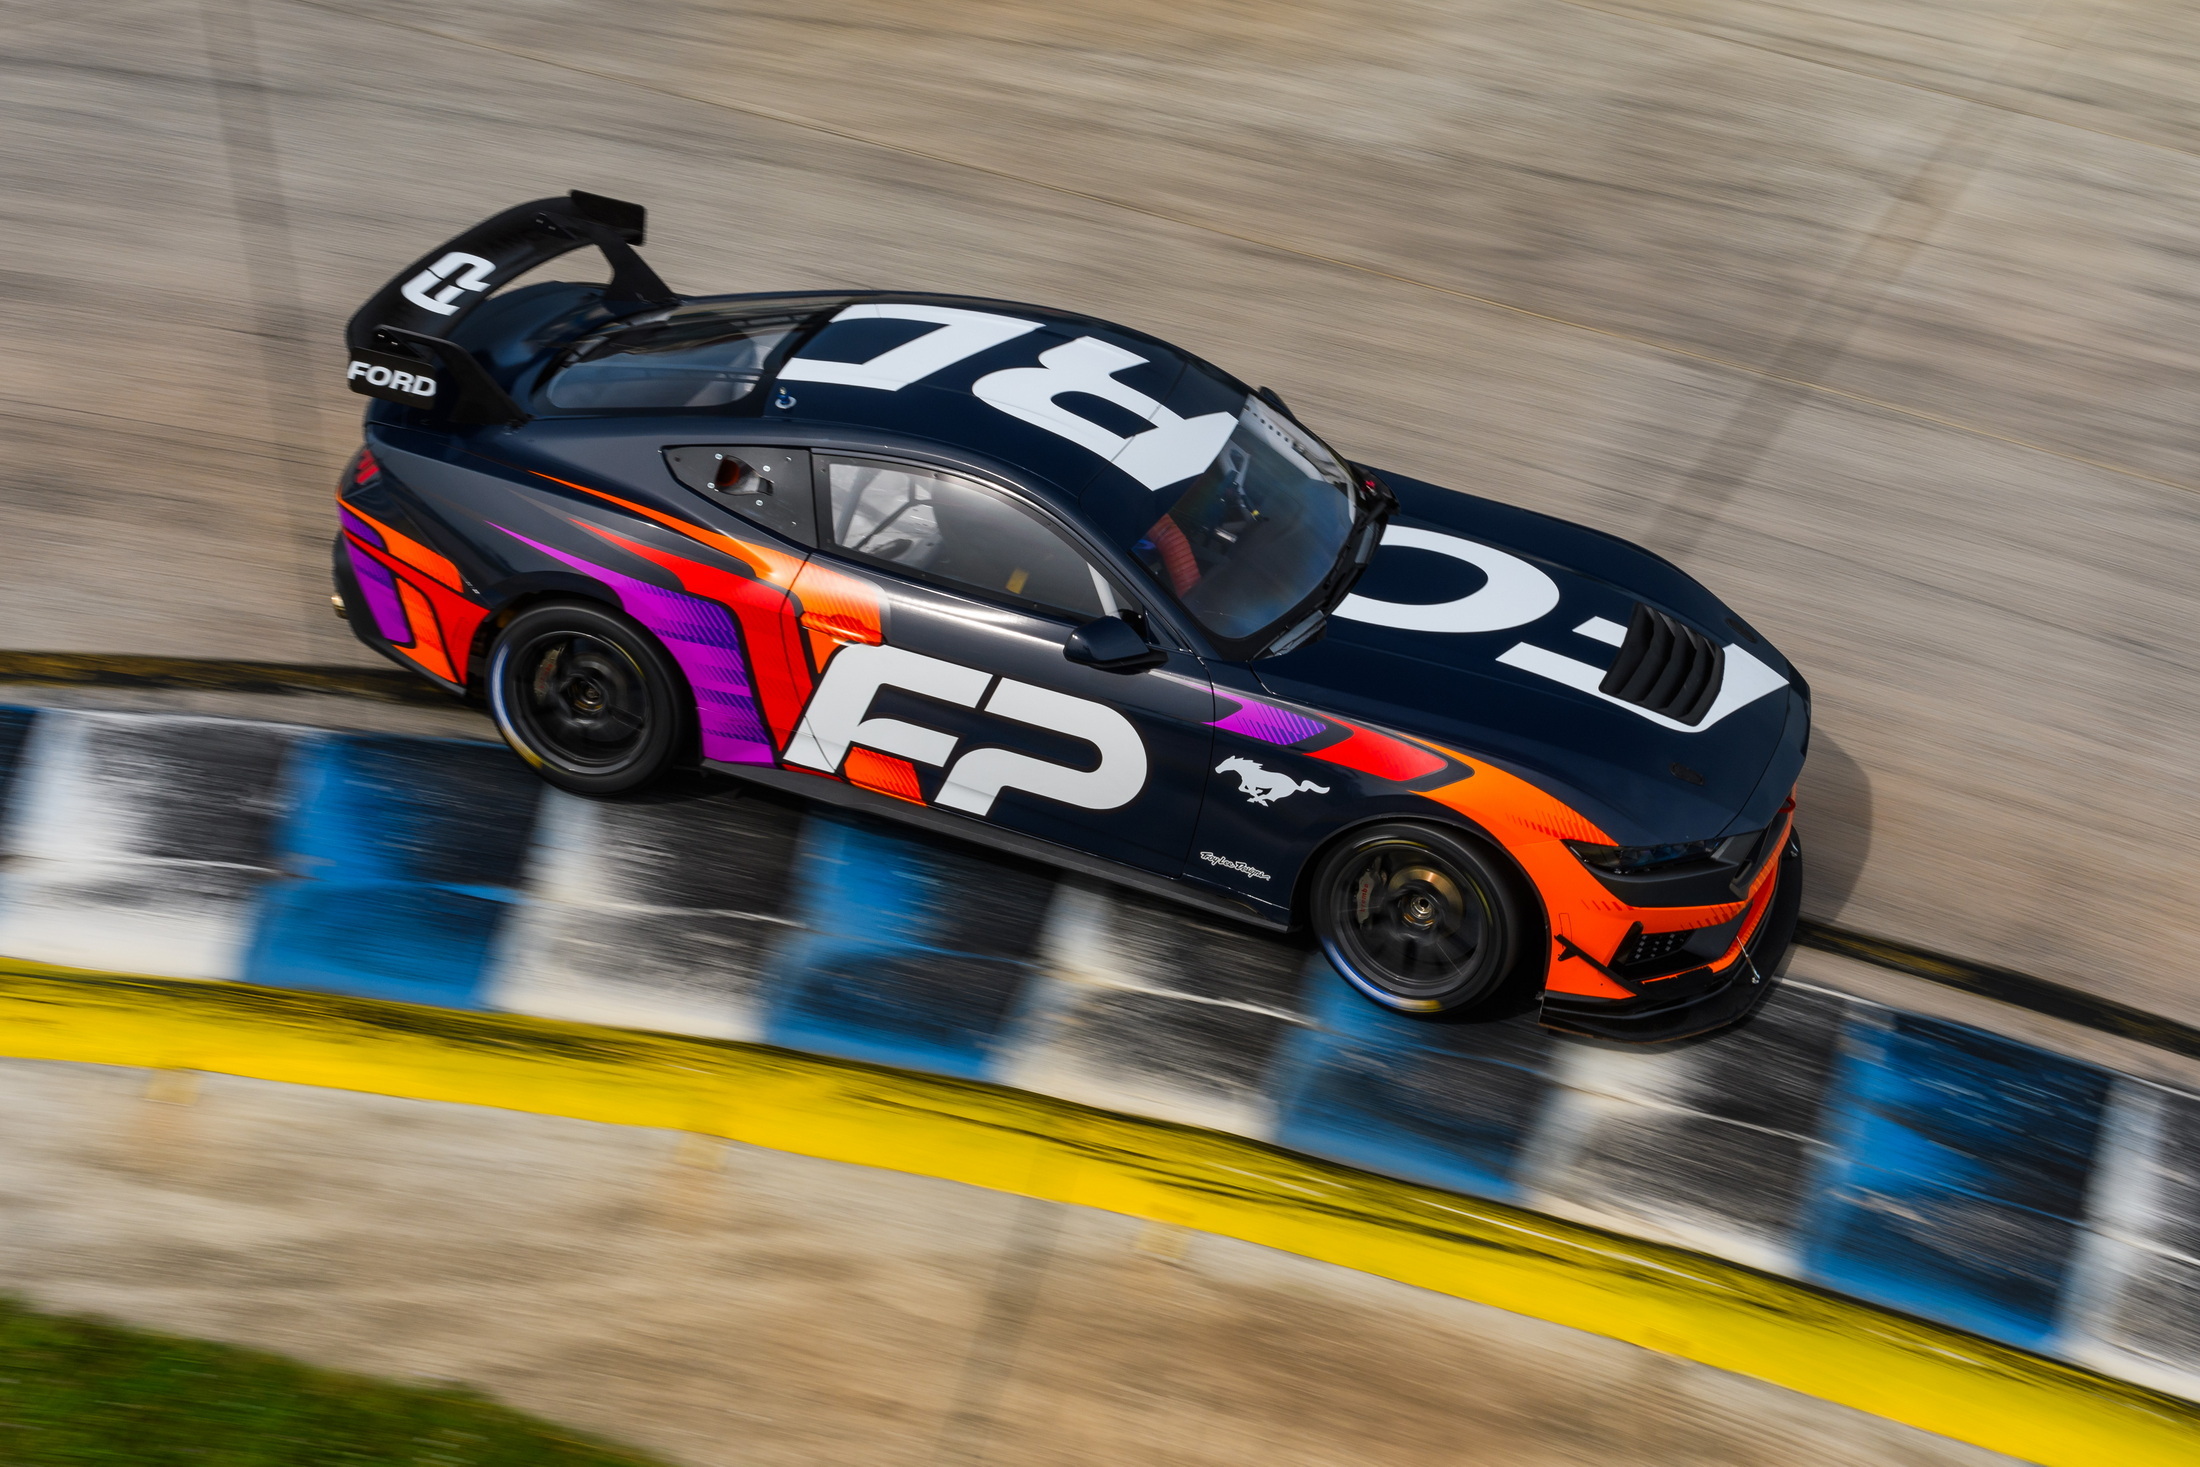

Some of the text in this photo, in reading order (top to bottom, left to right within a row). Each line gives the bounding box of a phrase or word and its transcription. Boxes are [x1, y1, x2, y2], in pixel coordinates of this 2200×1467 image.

[346, 360, 437, 397] FORD
[783, 643, 1148, 816] FP
[1200, 851, 1271, 881] Troy Lee Designs
